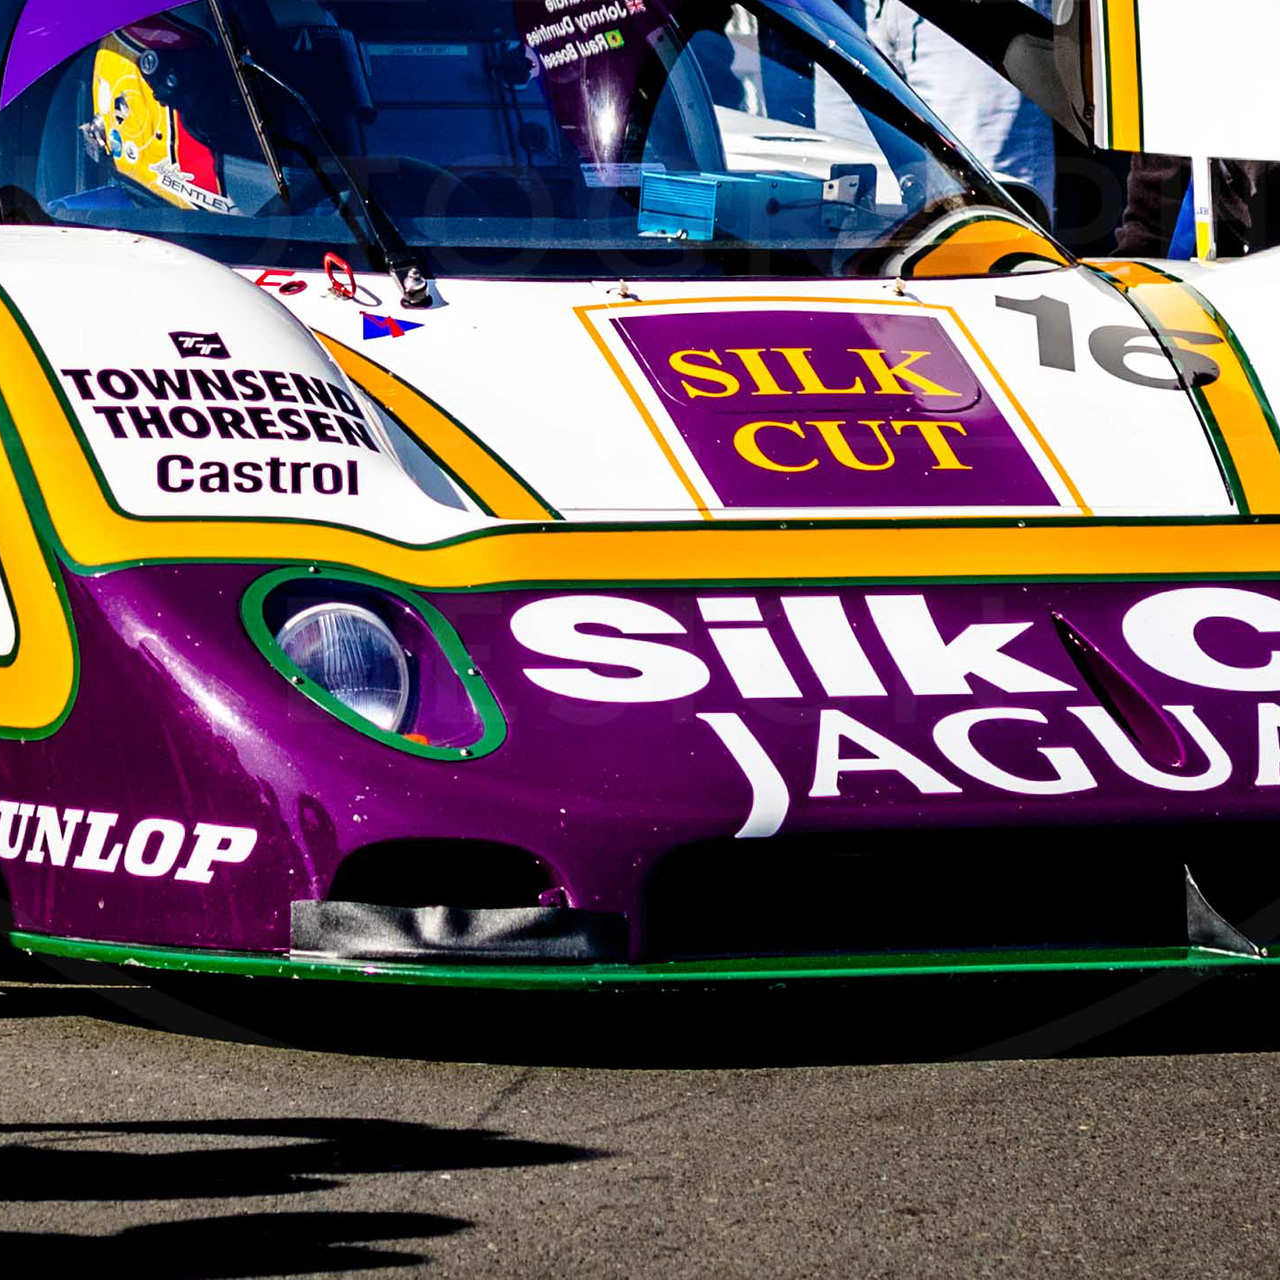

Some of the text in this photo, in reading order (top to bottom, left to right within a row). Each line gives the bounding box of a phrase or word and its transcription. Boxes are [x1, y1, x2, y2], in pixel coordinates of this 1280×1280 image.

[161, 175, 237, 213] BENTLEY
[994, 293, 1225, 393] 16
[62, 368, 368, 421] TOWNSEND
[668, 345, 963, 399] SILK
[95, 405, 382, 453] THORESEN
[732, 419, 974, 473] CUT
[156, 453, 360, 497] Castrol
[509, 594, 1076, 704] Silk
